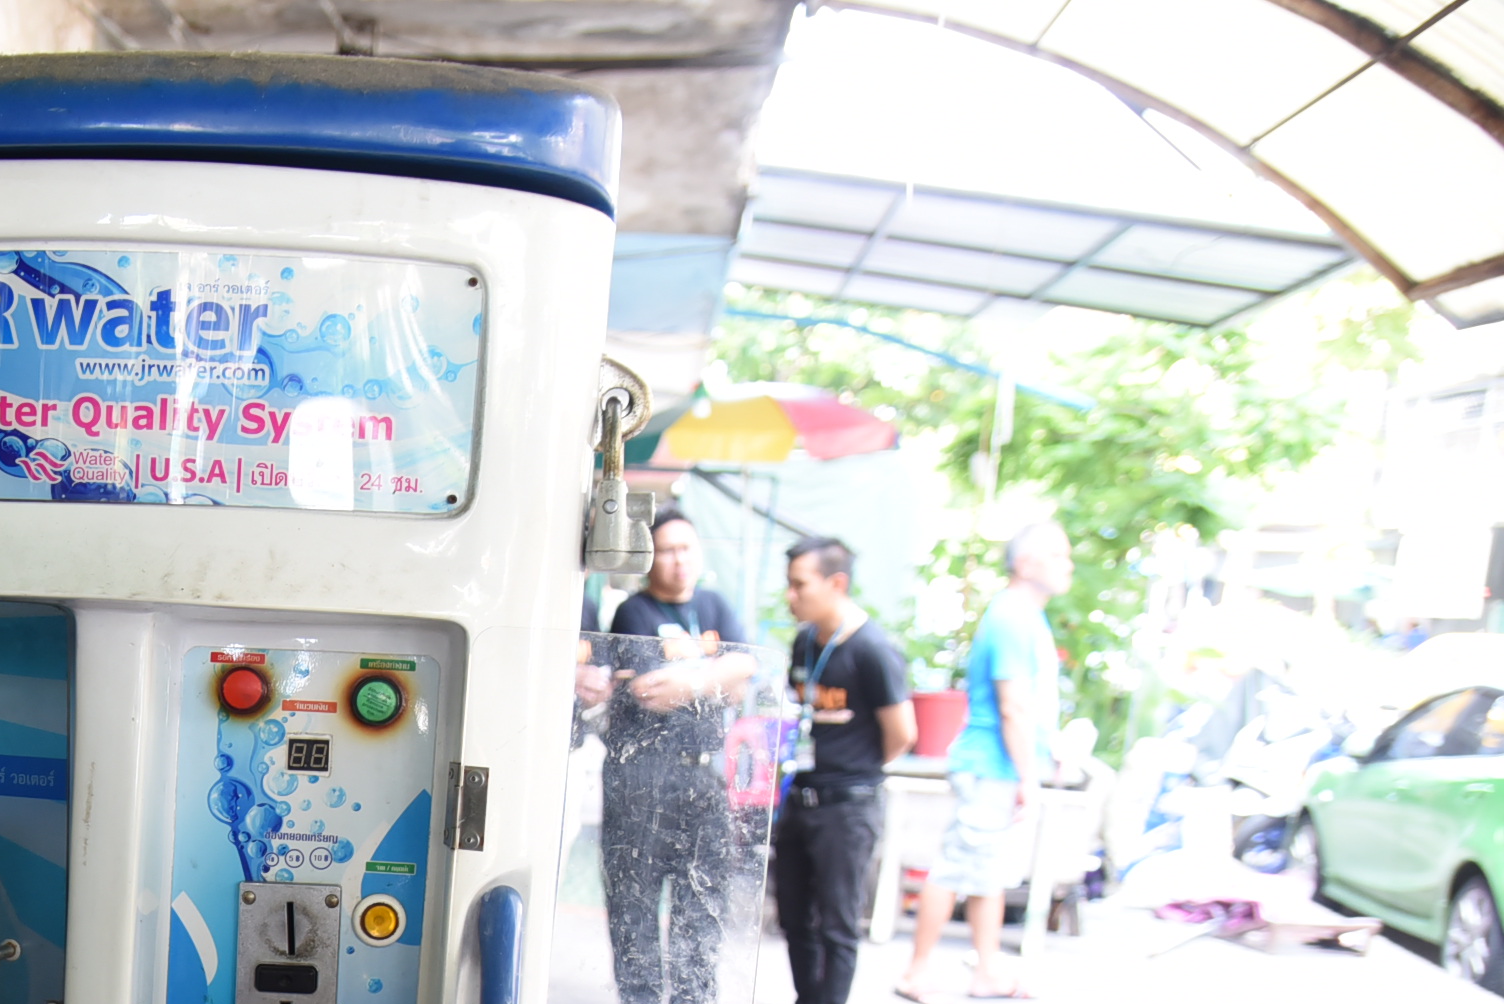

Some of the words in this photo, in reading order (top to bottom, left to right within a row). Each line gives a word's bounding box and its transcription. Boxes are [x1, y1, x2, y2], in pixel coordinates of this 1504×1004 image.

[225, 279, 270, 296] วอเตอร์
[30, 288, 269, 352] water
[80, 358, 266, 383] www.jrwater.com
[72, 396, 227, 441] Quality
[240, 402, 393, 444] Sysm
[73, 451, 120, 466] Water
[72, 467, 127, 485] Quality
[150, 457, 228, 485] U.S.A
[360, 472, 383, 491] 24
[391, 476, 423, 494] ชม.
[10, 770, 55, 787] วอเตอร์
